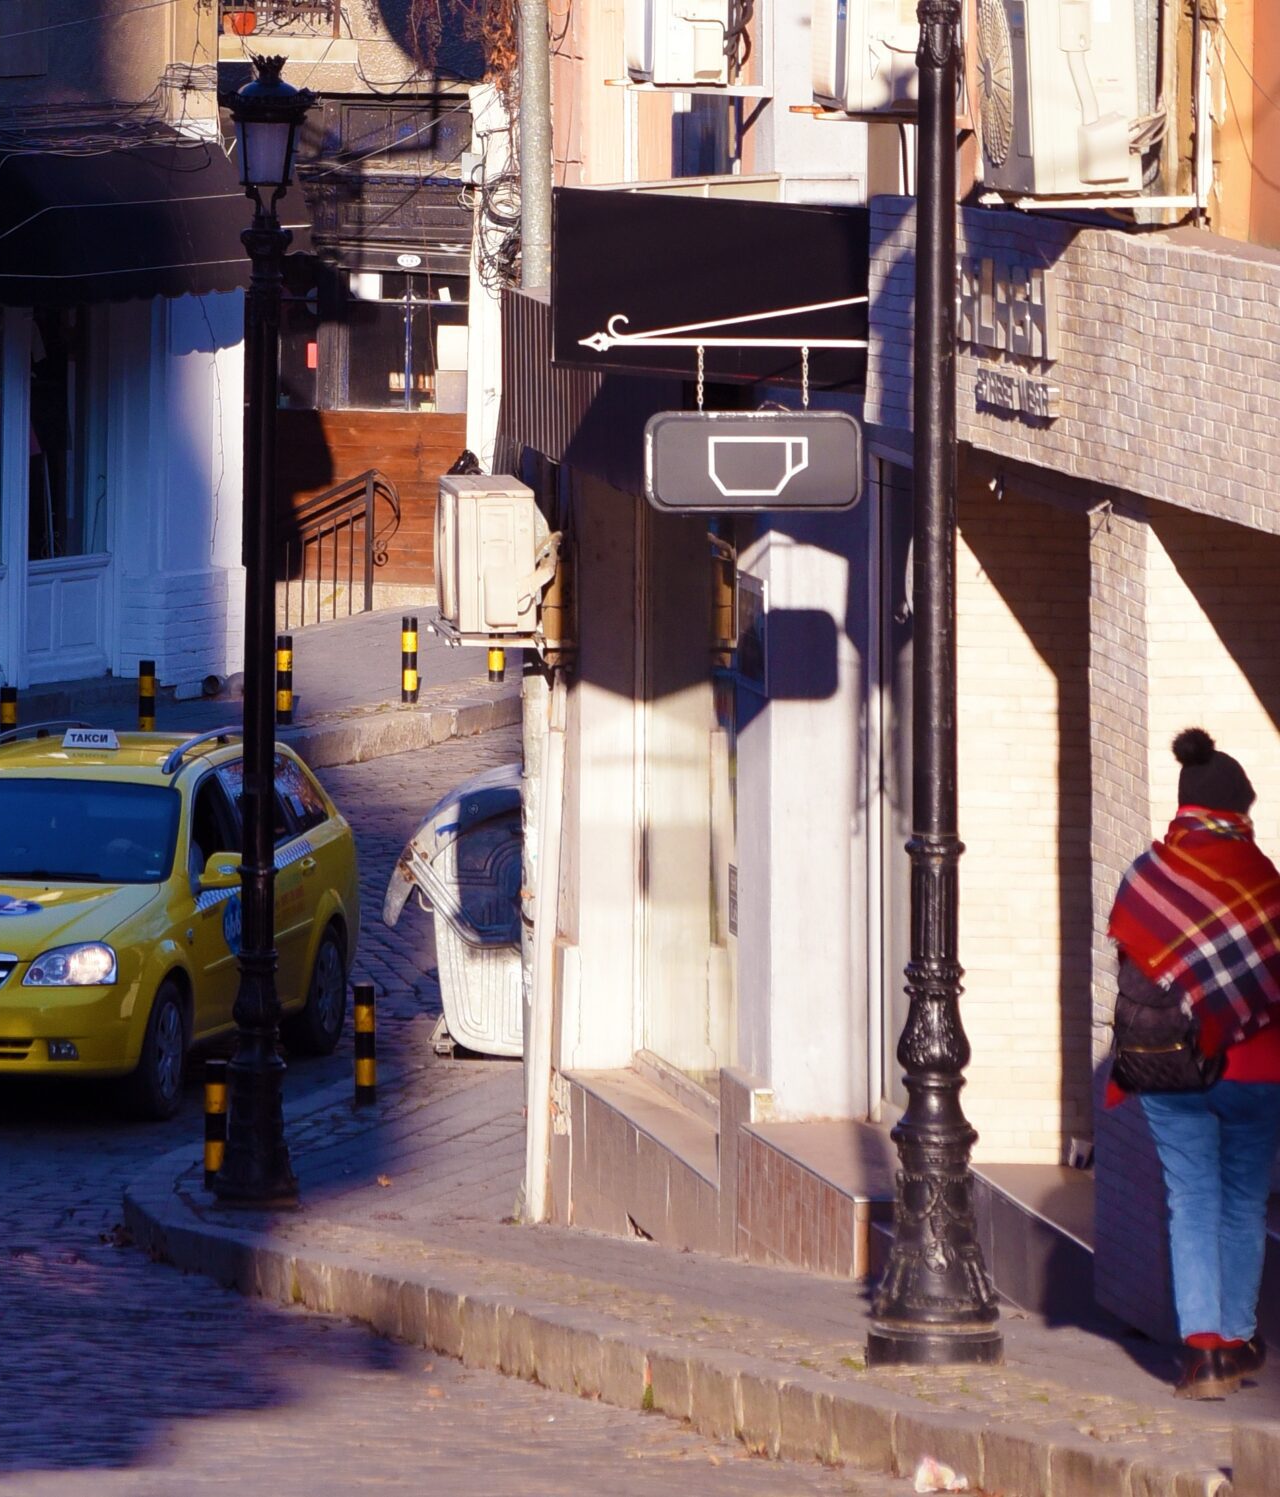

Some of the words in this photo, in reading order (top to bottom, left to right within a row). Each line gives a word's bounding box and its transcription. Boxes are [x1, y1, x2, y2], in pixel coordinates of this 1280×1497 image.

[975, 368, 1018, 410] STREET
[1017, 377, 1058, 418] WEAR
[71, 734, 109, 743] ТАКСИ
